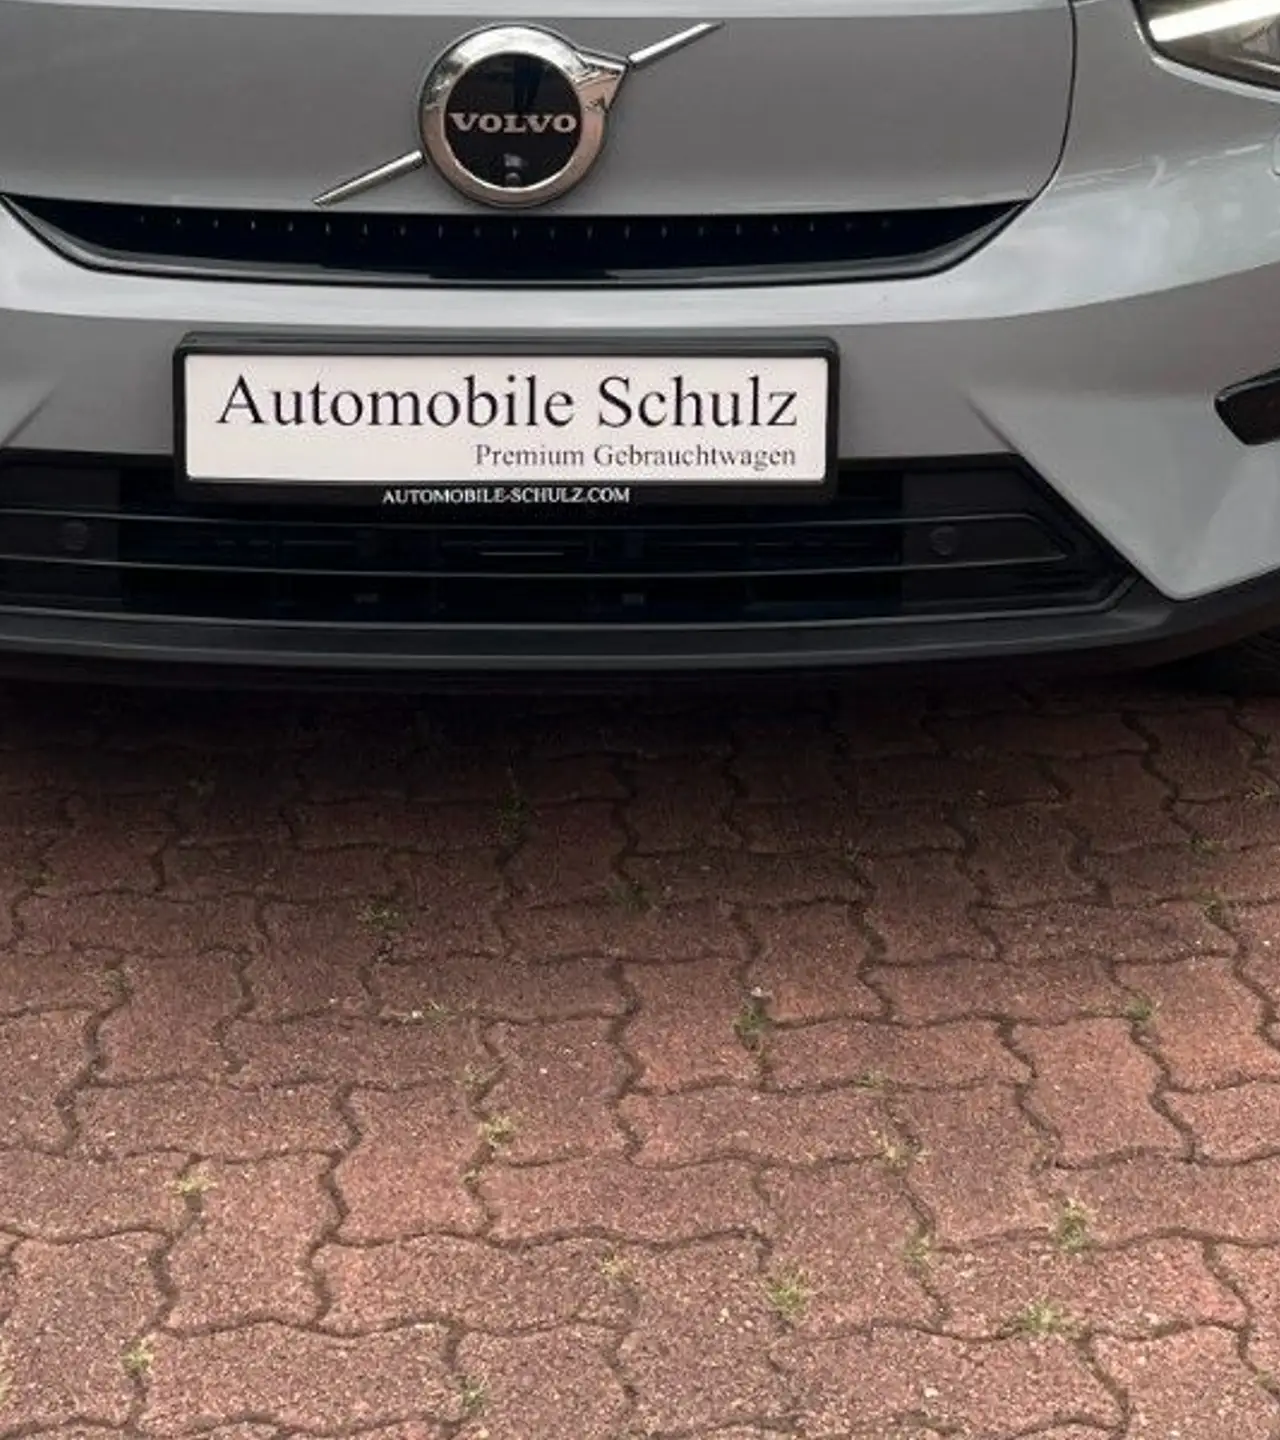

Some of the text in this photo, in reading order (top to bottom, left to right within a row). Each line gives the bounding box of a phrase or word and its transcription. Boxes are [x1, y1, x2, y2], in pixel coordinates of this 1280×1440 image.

[449, 112, 577, 134] VOLVO
[216, 374, 799, 429] Automobile Schulz
[475, 443, 797, 472] Premium Gebrauchtwagen
[381, 486, 631, 505] AUTOMOBILE-SCHULZ.COM
